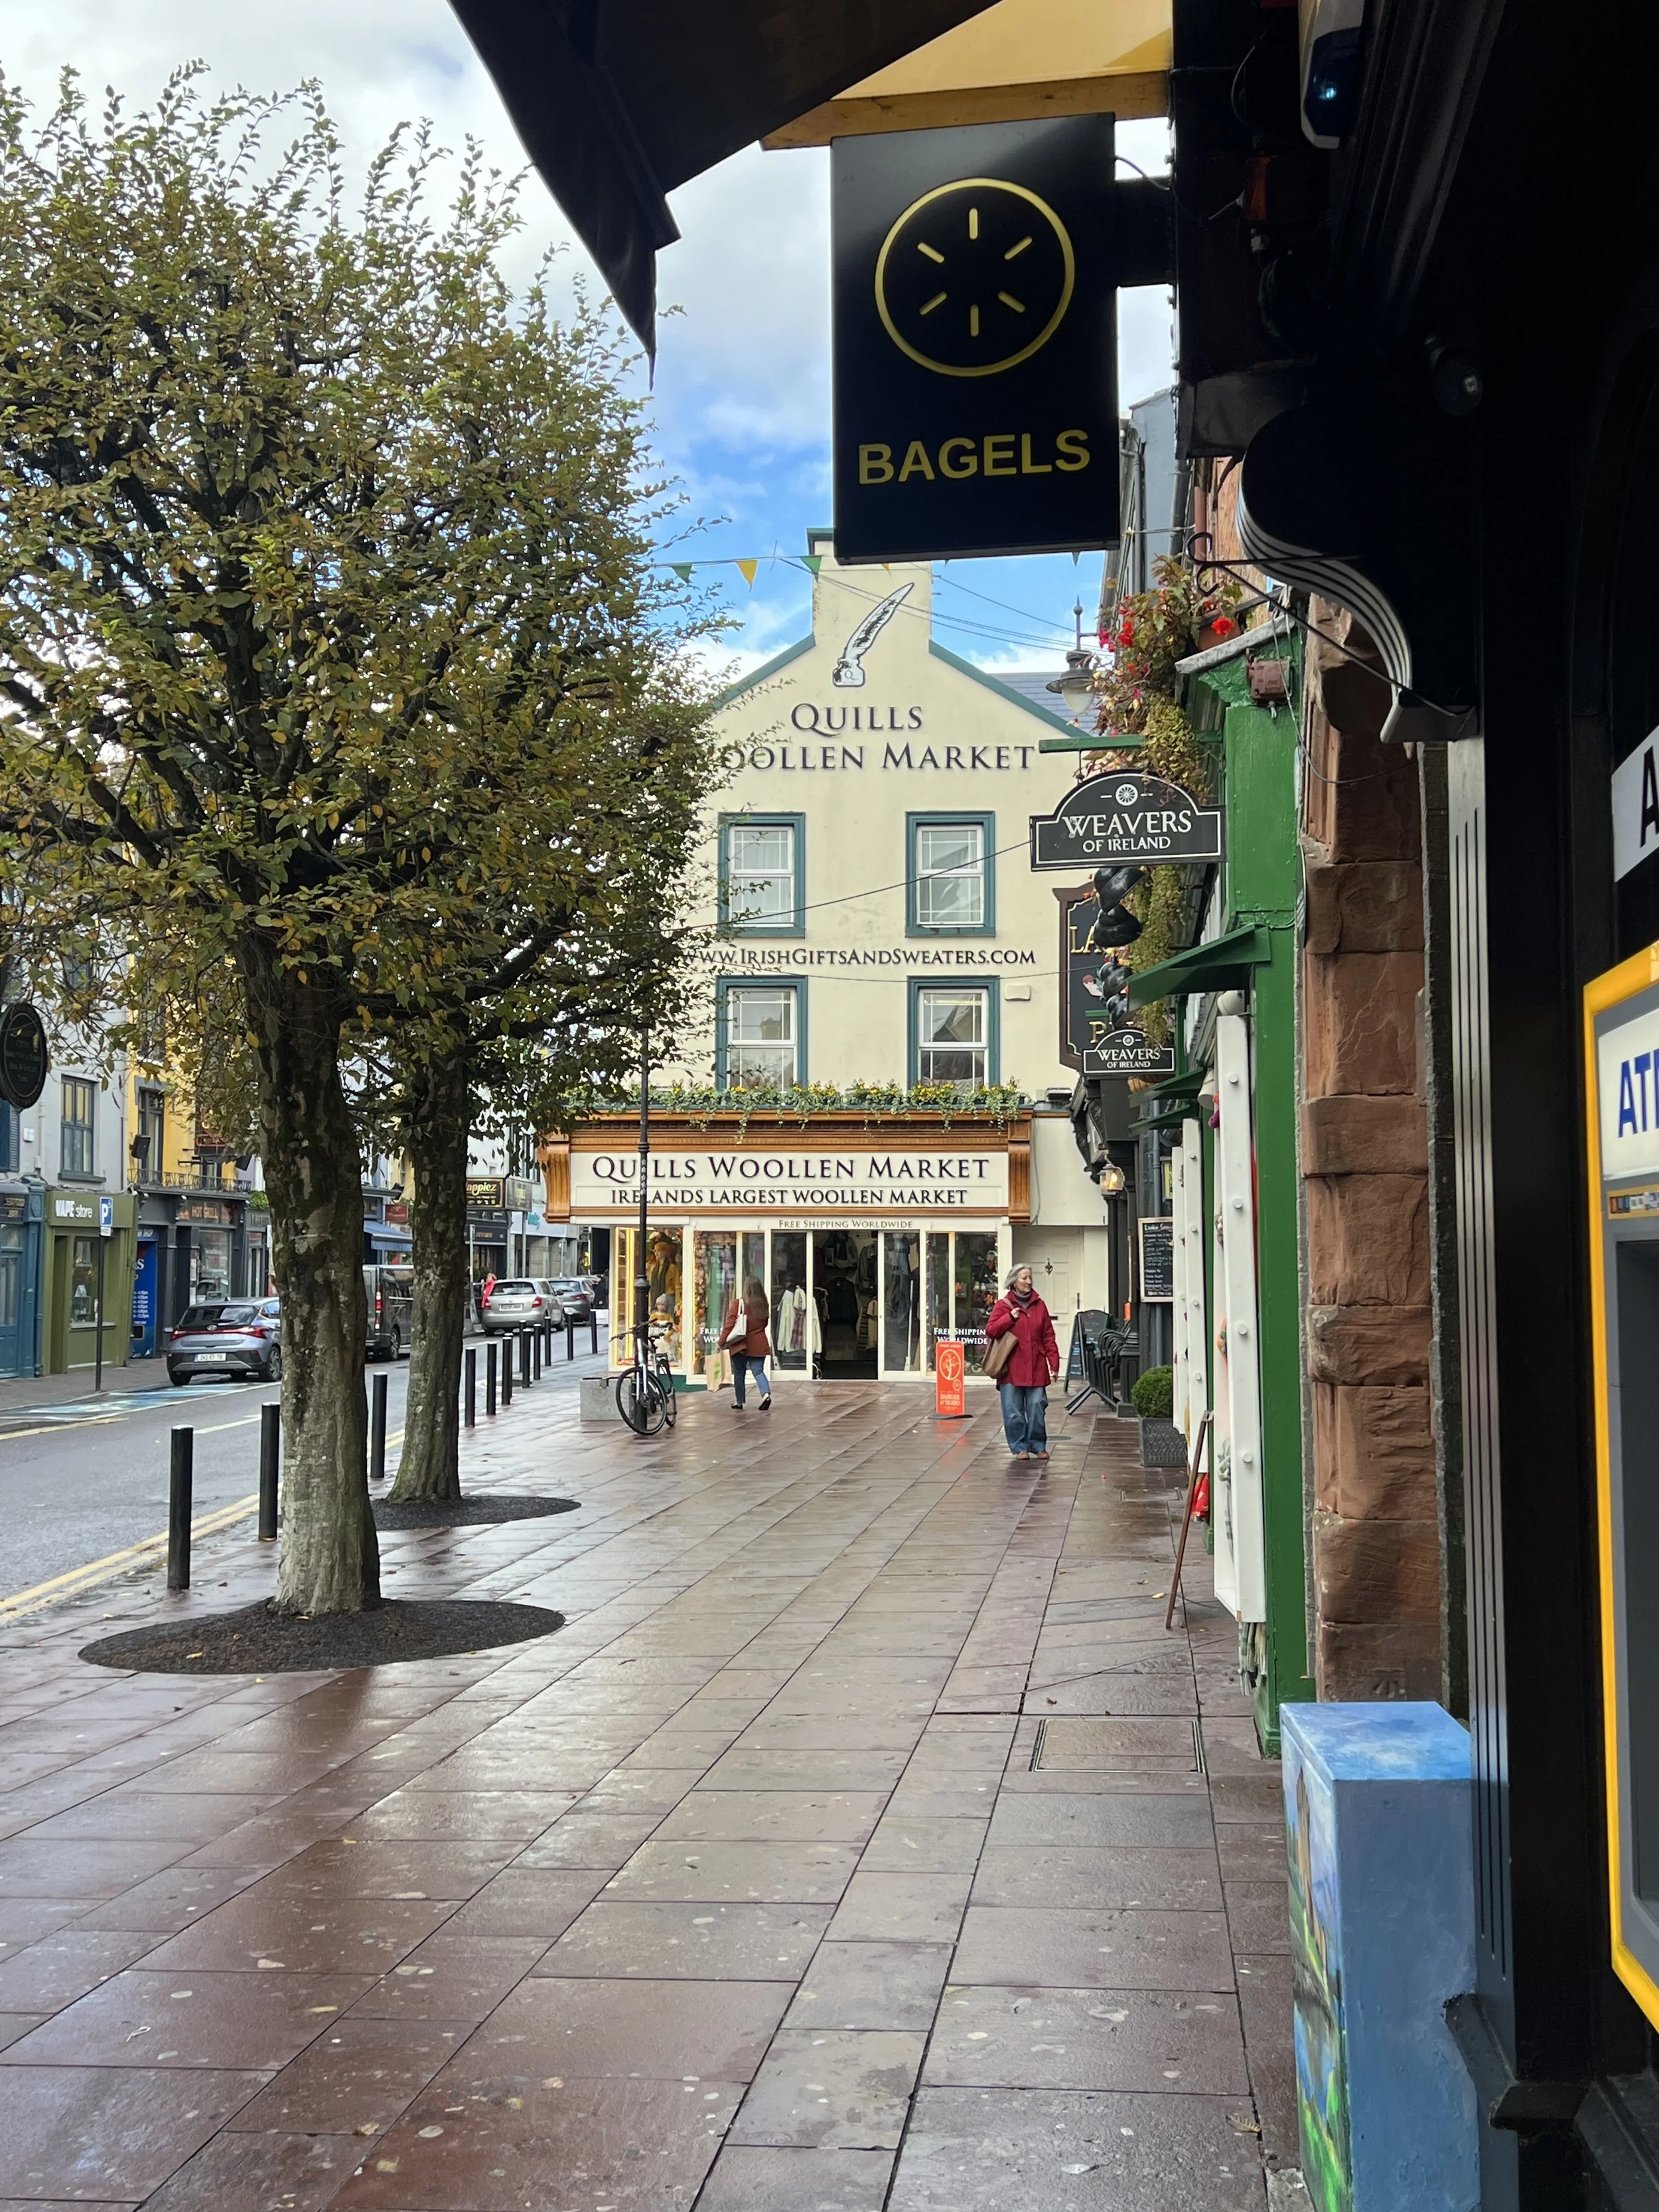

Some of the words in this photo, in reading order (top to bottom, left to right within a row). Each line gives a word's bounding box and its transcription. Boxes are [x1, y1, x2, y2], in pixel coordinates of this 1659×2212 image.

[859, 429, 1090, 485] BAGELS
[790, 703, 923, 737] QUILLS
[721, 745, 865, 771] OOLLEN
[882, 742, 1035, 771] MARKET
[1062, 810, 1192, 838] WEAVERS
[1082, 839, 1104, 853] OF
[1108, 836, 1171, 851] IRELAND
[1097, 1047, 1161, 1061] WEAVERS
[592, 1155, 696, 1184] QULLS
[707, 1155, 855, 1179] WOOLLEN
[867, 1155, 989, 1179] MARKET
[611, 1189, 703, 1204] IREANDS
[710, 1189, 788, 1204] LARGEST
[793, 1189, 883, 1204] WOOLLEN
[889, 1189, 968, 1204] MARKET
[56, 1199, 75, 1218] VAPE
[75, 1203, 93, 1218] store
[102, 1203, 109, 1224] P
[192, 1205, 203, 1217] HOT
[778, 1220, 800, 1228] FREE
[803, 1220, 849, 1228] SHIPPING
[851, 1220, 912, 1228] WORLDWIDE
[955, 1327, 986, 1336] SHIPPIN
